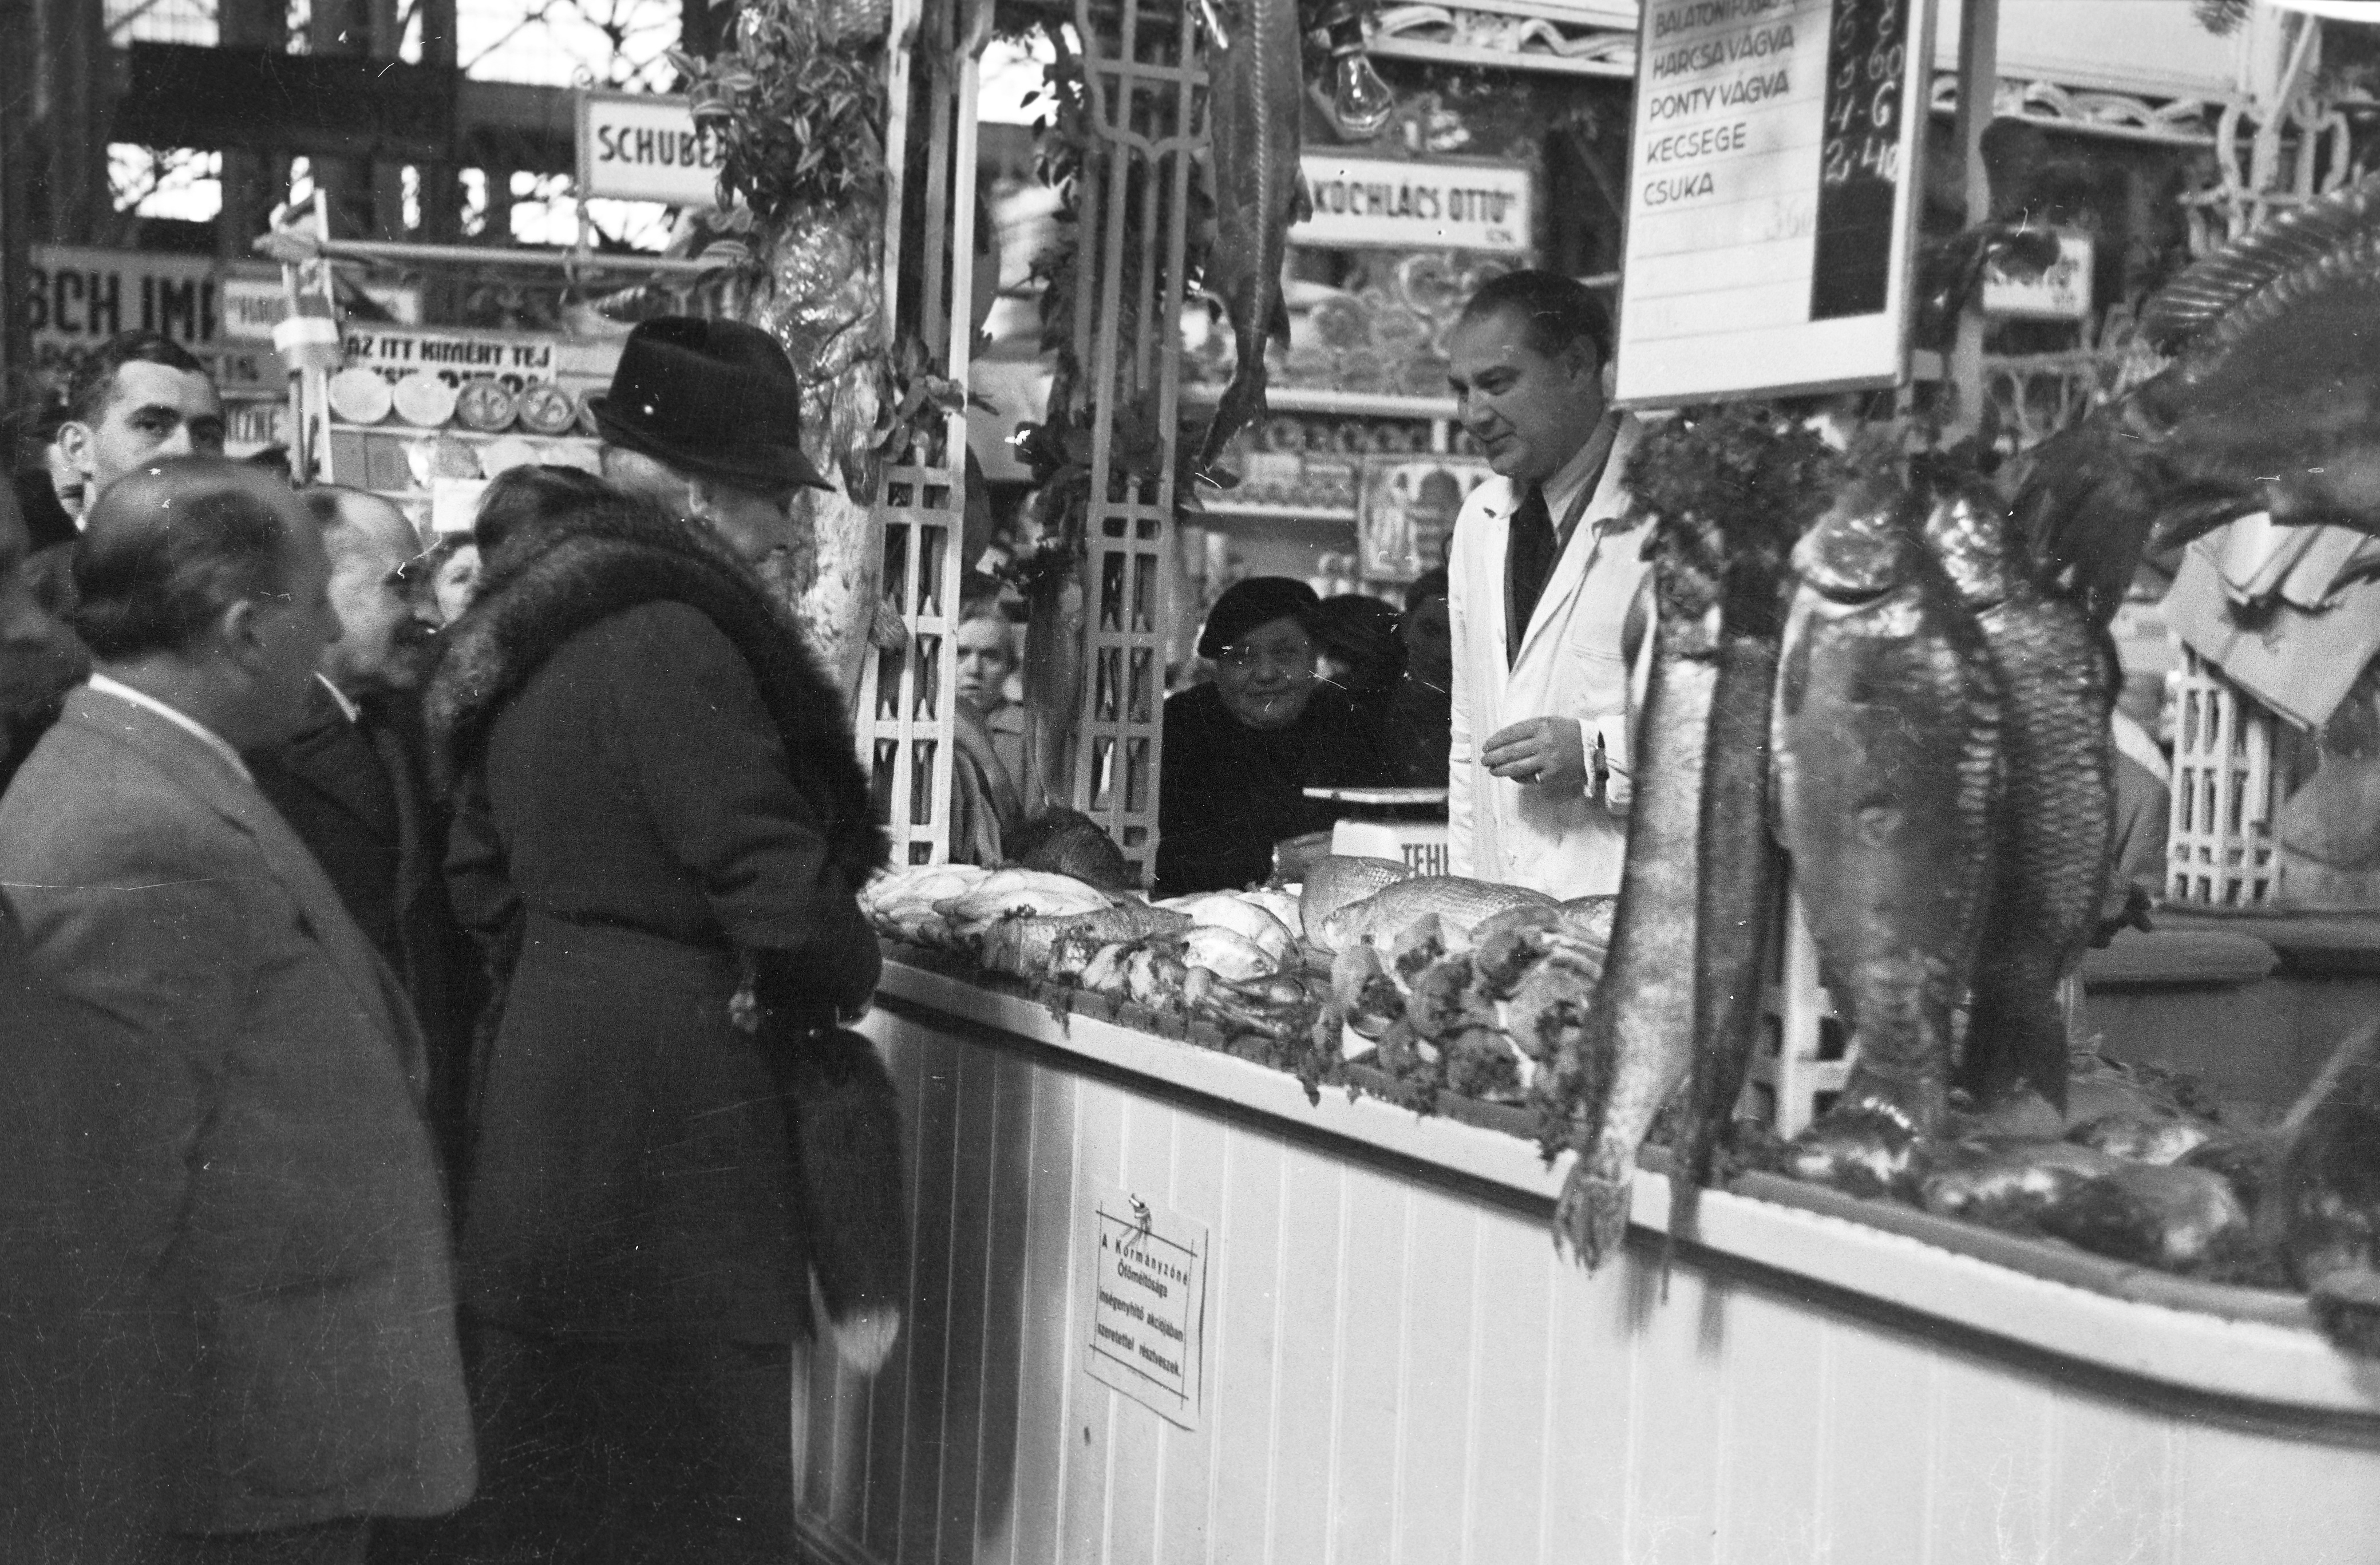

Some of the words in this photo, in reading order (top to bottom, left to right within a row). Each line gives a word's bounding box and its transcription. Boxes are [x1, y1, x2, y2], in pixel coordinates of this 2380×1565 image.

[1647, 122, 1747, 164] KECSEGE
[1644, 173, 1714, 206] CSUKA
[513, 345, 550, 367] TEJ
[1102, 1234, 1108, 1249] A
